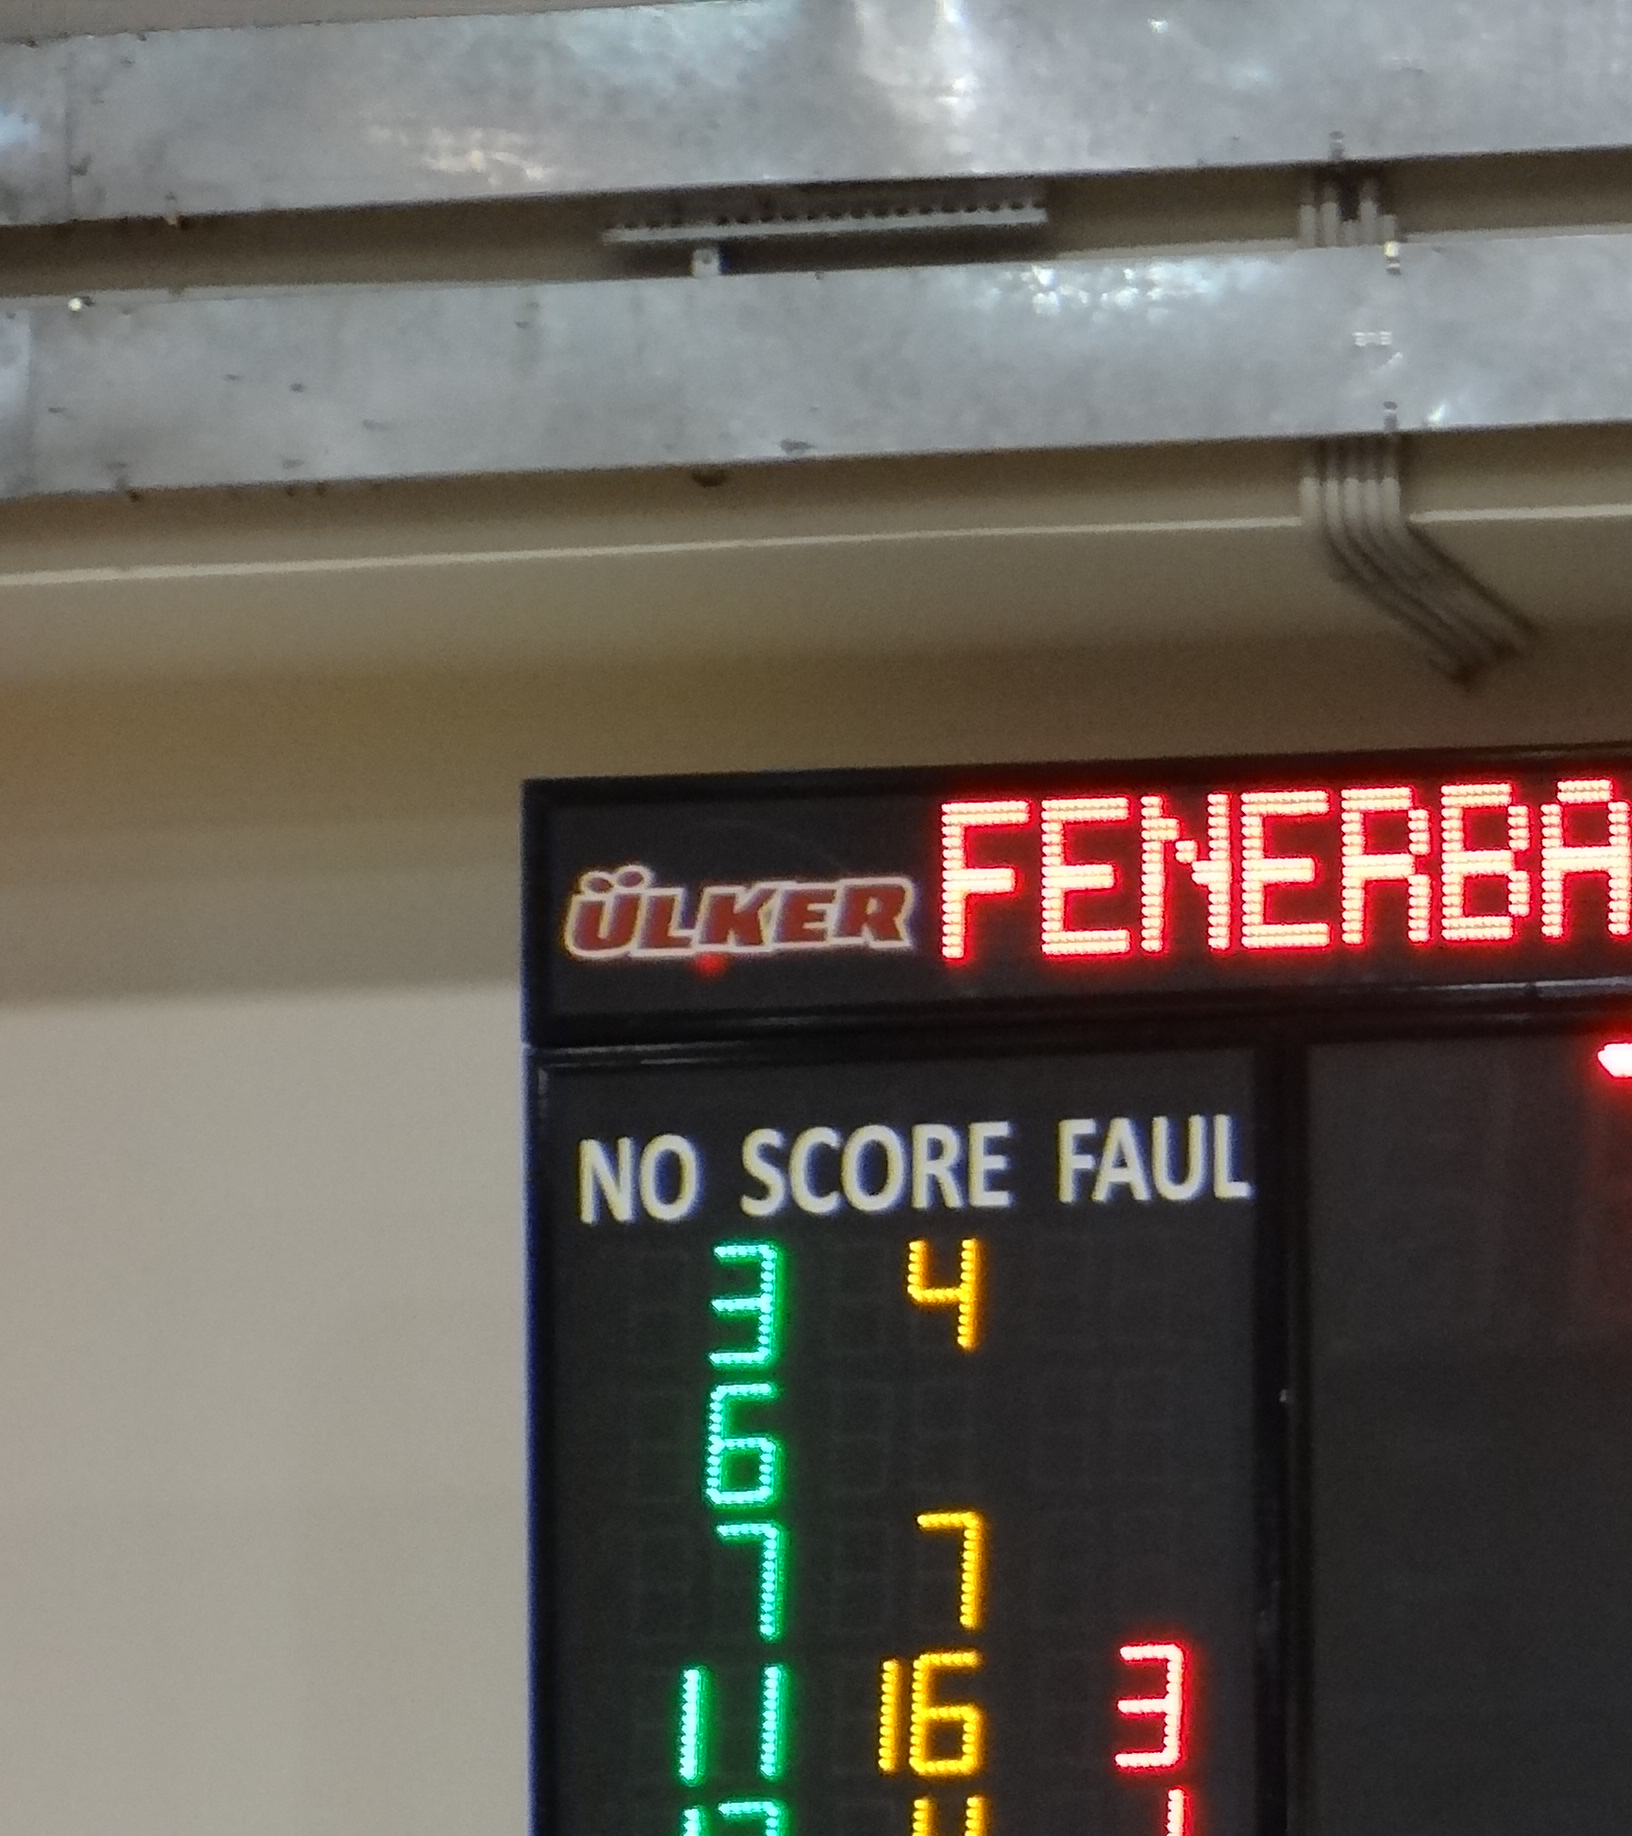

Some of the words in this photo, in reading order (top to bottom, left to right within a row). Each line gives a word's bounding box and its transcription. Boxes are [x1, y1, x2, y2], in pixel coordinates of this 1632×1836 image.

[562, 862, 916, 960] ÜLKER
[578, 1134, 702, 1224] NO
[740, 1118, 1014, 1218] SCORE
[1057, 1112, 1254, 1202] FAUL
[708, 1242, 783, 1369] 3
[906, 1237, 981, 1350] 4
[704, 1381, 781, 1507] 6
[715, 1521, 786, 1642] 7
[916, 1510, 984, 1629] 7
[677, 1665, 789, 1785] 11
[877, 1650, 983, 1777] 16
[1113, 1639, 1194, 1776] 3
